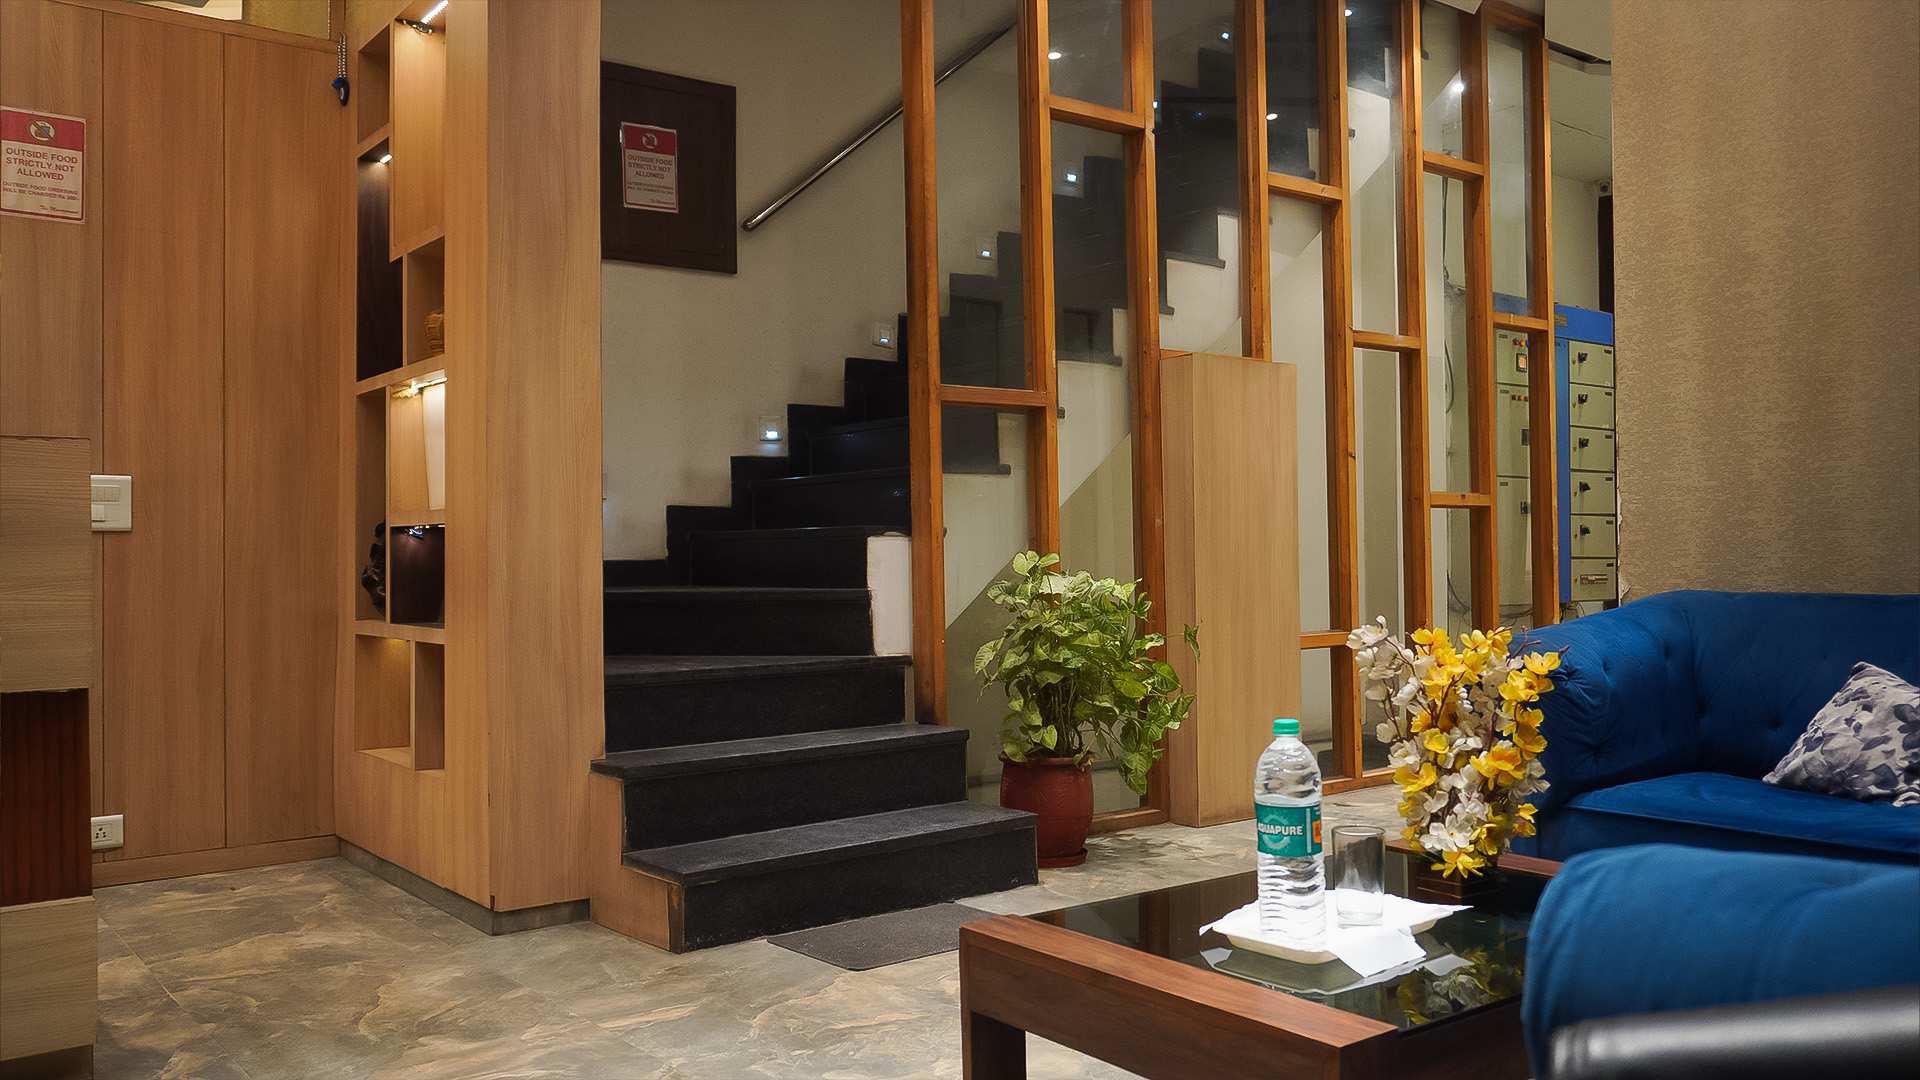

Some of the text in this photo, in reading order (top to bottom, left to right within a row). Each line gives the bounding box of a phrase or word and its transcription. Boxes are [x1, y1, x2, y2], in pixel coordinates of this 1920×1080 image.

[6, 147, 78, 164] OUTSIDE FOOD
[628, 154, 673, 166] OUTSIDE FOOD
[5, 157, 75, 173] STRICTLY NOT
[628, 161, 672, 173] STRICTLY NOT
[17, 168, 64, 180] ALLOWED
[634, 170, 665, 179] ALLOWED
[3, 181, 29, 189] OUTSIDE
[48, 186, 78, 195] ORDERING
[28, 190, 57, 199] CHARGED
